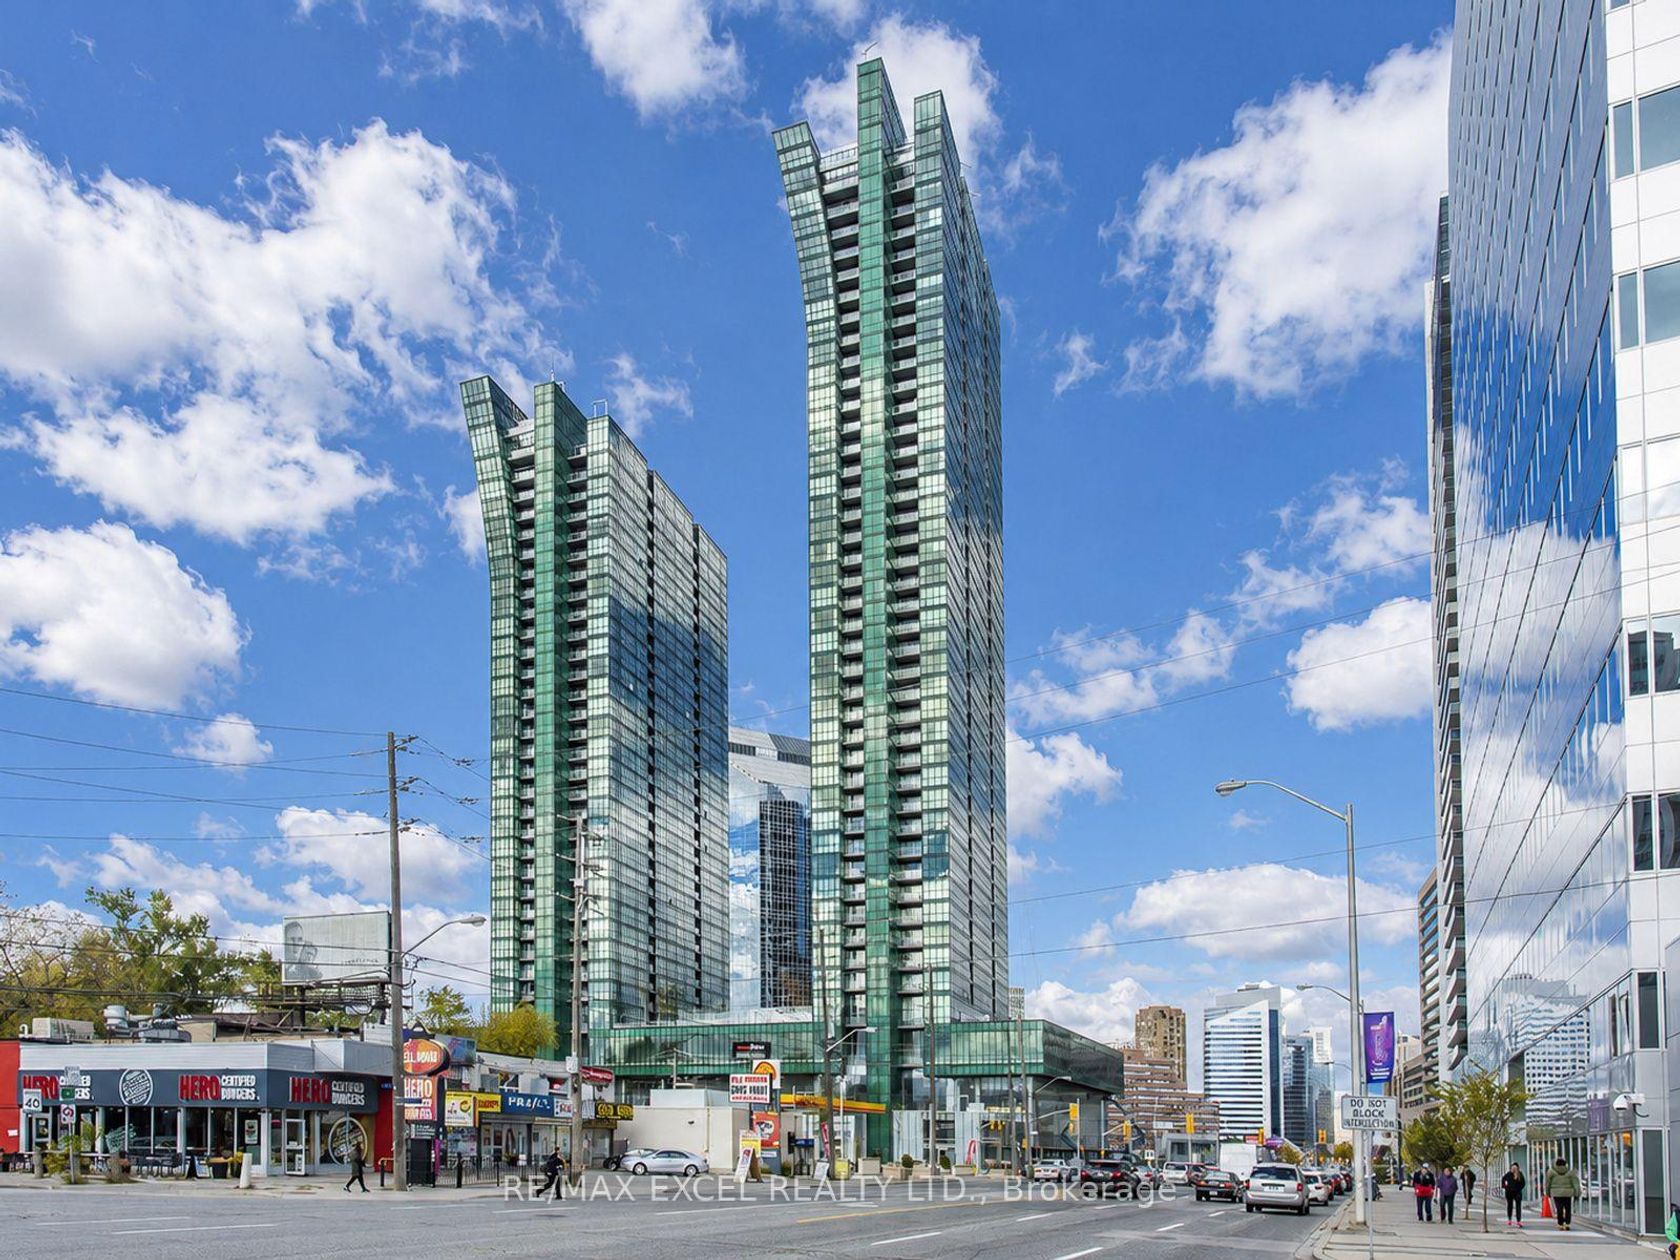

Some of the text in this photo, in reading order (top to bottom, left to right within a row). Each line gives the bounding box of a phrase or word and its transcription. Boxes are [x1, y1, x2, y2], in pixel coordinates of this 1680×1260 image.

[179, 1075, 221, 1101] HERO
[289, 1077, 331, 1104] HERO
[25, 1098, 40, 1108] 40
[1350, 1099, 1387, 1108] DO NOT
[1353, 1109, 1385, 1118] BLOCK
